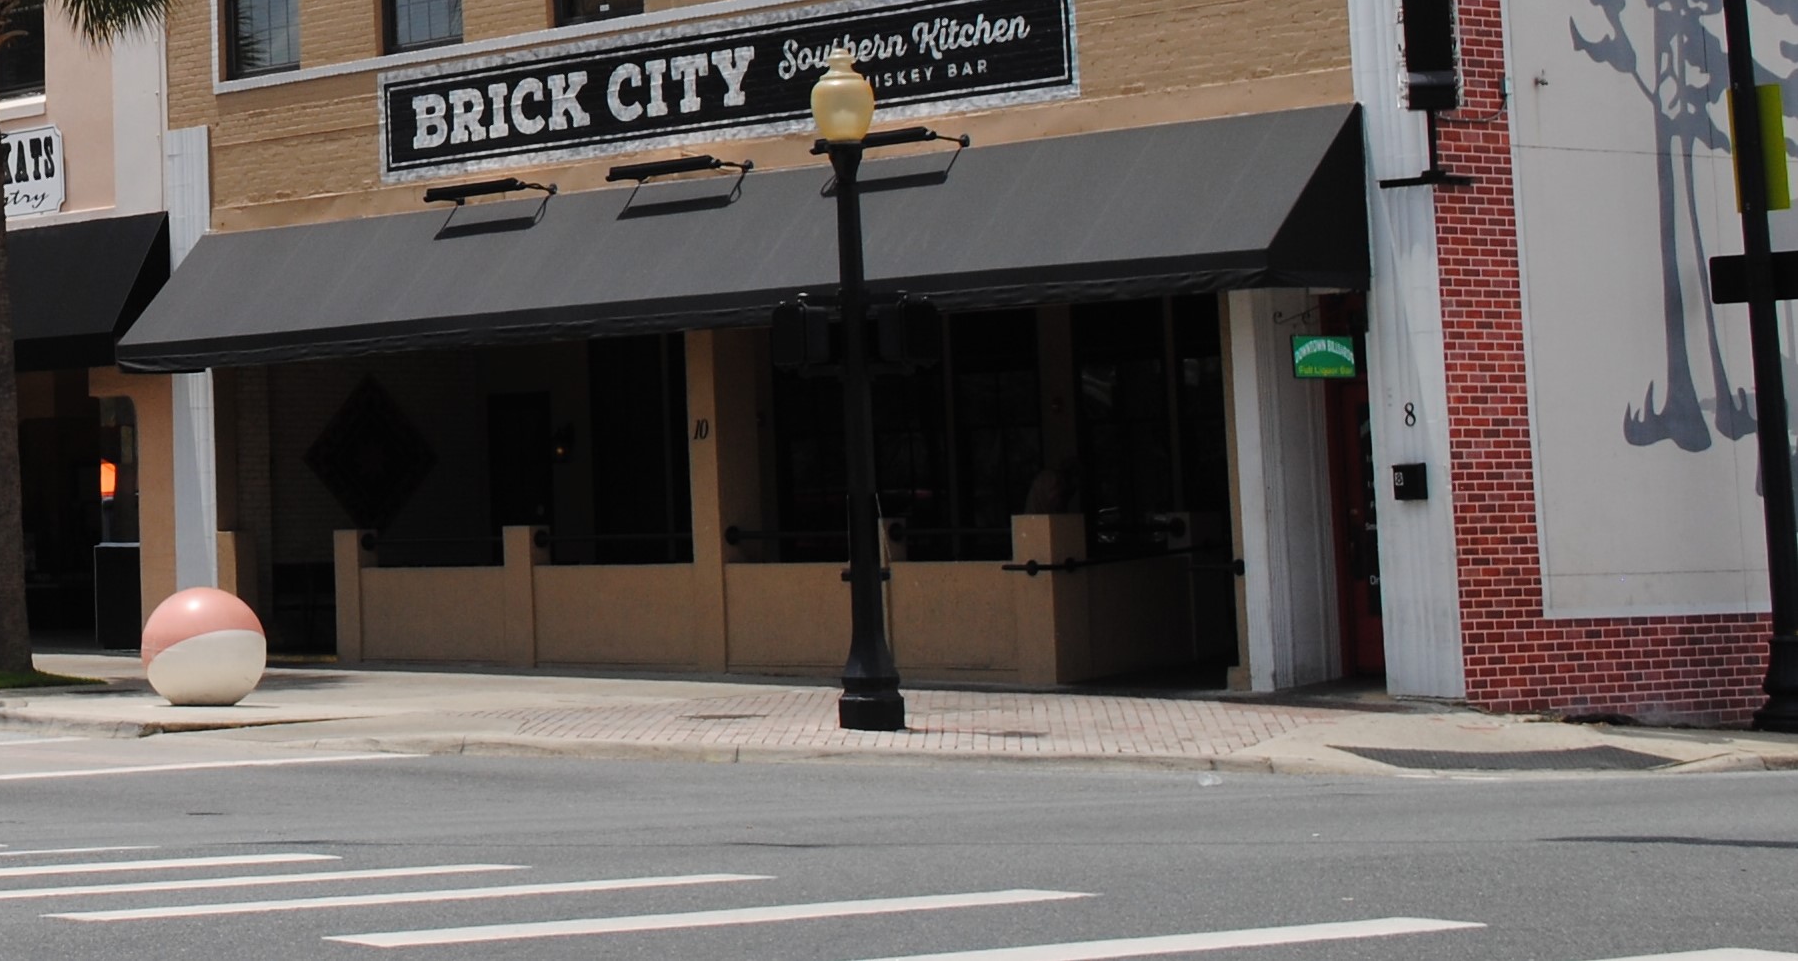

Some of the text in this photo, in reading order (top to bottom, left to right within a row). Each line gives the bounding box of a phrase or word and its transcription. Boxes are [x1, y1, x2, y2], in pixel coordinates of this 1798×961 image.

[779, 14, 1031, 80] Souhern Kitchen
[865, 60, 988, 88] ISKEY BAR
[412, 46, 755, 150] BRICK CITY
[1404, 402, 1416, 427] 8
[693, 418, 709, 440] 10
